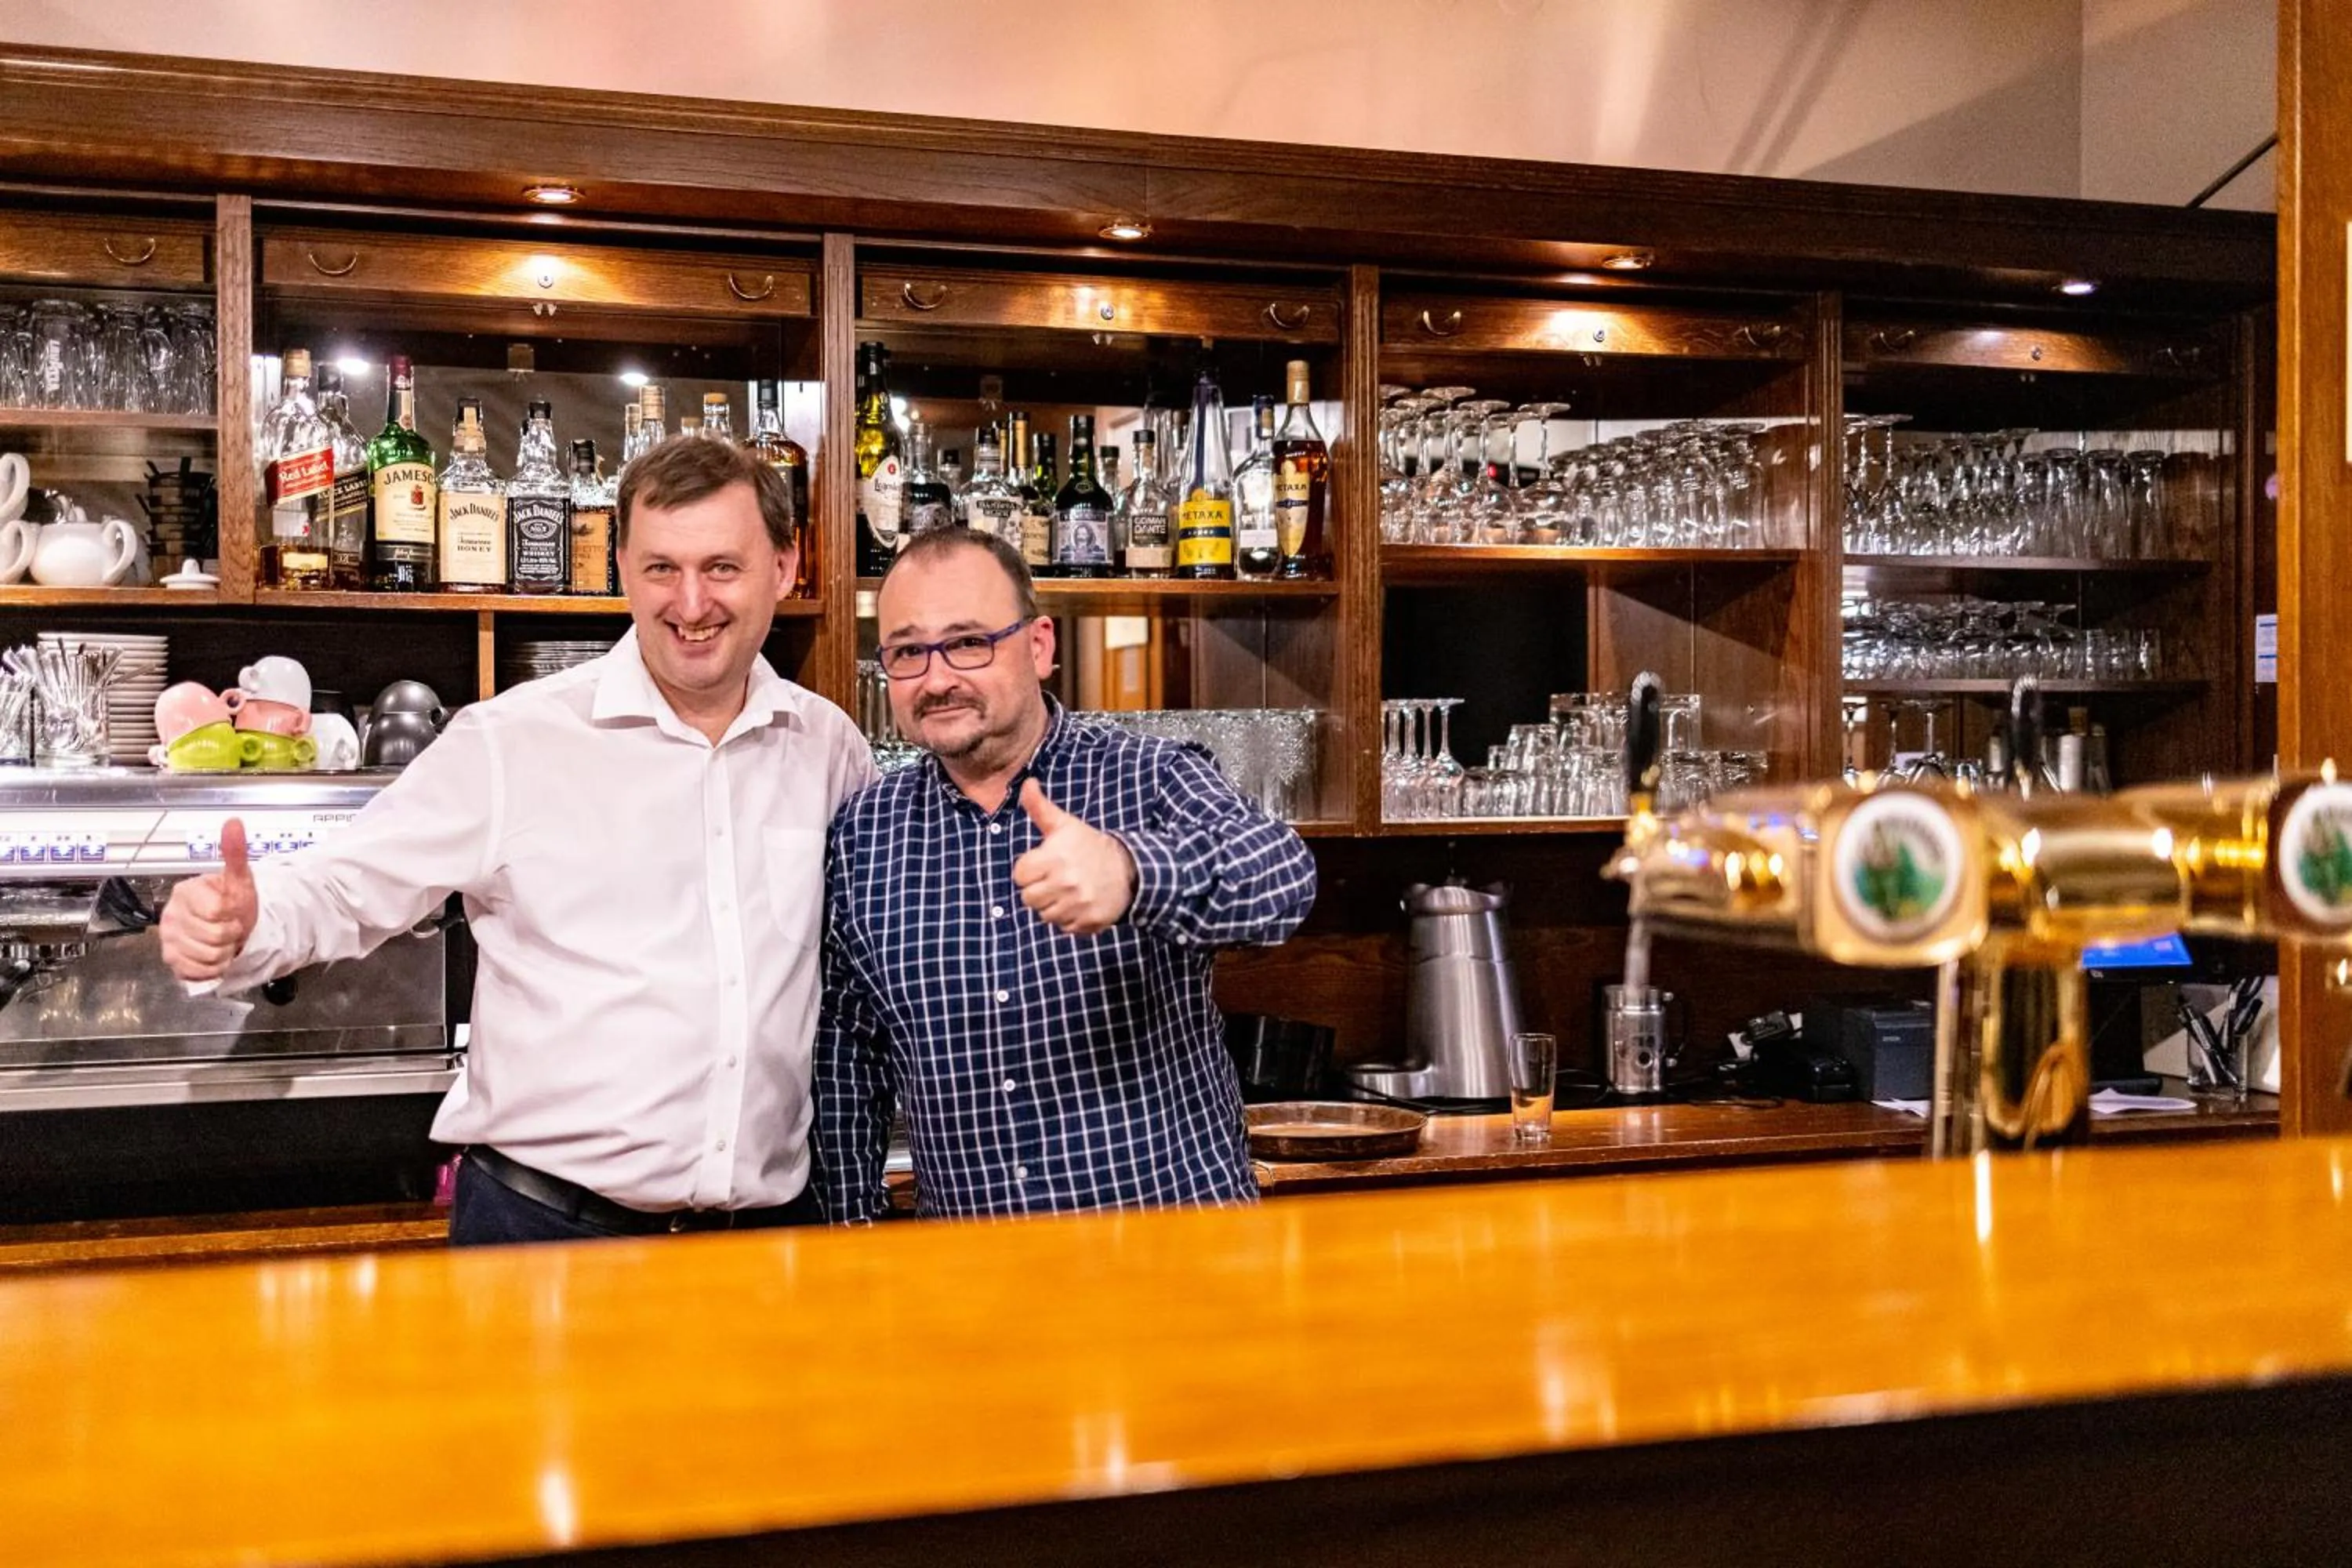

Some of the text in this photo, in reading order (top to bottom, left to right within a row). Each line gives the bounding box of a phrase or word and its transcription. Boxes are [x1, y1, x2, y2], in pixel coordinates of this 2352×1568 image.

[383, 470, 434, 485] JAMESO
[1276, 483, 1307, 492] ETAXA
[1134, 524, 1166, 534] DANTE
